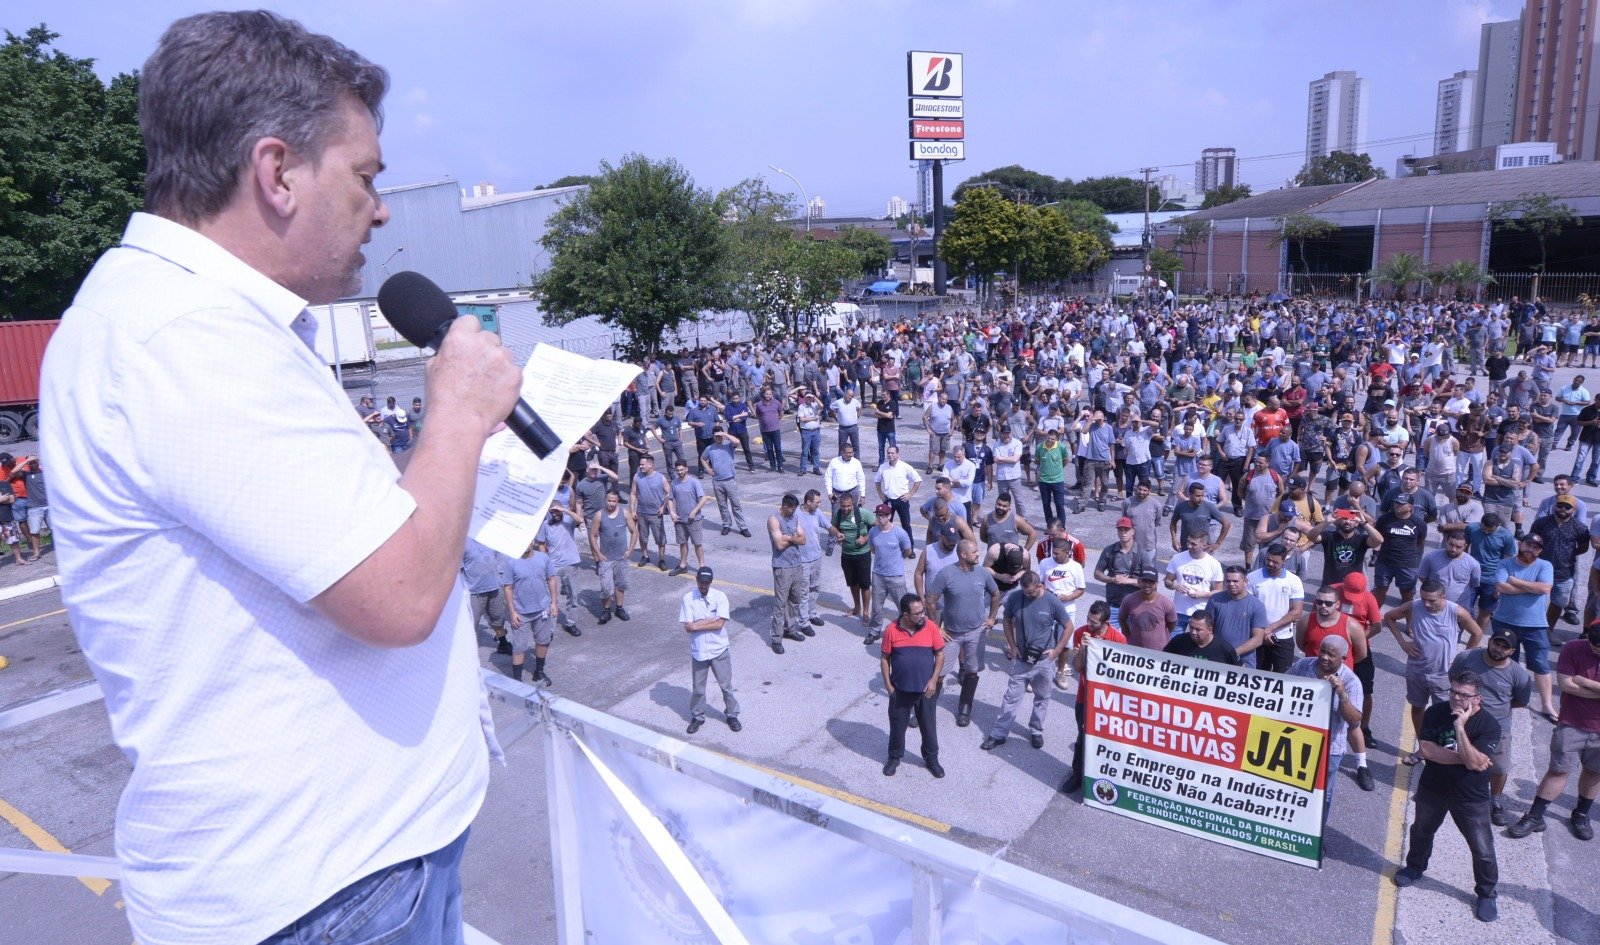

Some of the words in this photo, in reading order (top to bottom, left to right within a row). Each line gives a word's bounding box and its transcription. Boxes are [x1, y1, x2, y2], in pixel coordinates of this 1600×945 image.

[915, 104, 961, 112] BRIDGESTONE
[915, 125, 962, 133] Firestone
[920, 144, 957, 156] bandag
[1096, 663, 1208, 698] Concorrência
[1214, 686, 1284, 713] Desleal
[1289, 702, 1313, 717] !!!
[1102, 647, 1155, 669] Vamos
[1160, 659, 1188, 676] dar
[1194, 667, 1219, 682] um
[1226, 671, 1284, 694] BASTA
[1291, 686, 1314, 701] na
[1093, 688, 1237, 738] MEDIDAS
[1094, 712, 1236, 763] PROTETIVAS
[1096, 745, 1121, 762] Pro
[1126, 753, 1195, 781] Emprego
[1201, 772, 1224, 787] na
[1228, 778, 1308, 808] Indústria
[1246, 727, 1312, 781] JÁ!
[1100, 763, 1117, 777] de
[1122, 769, 1172, 792] PNEUS
[1177, 783, 1207, 802] Não
[1212, 790, 1295, 822] Acabar!!!
[1127, 791, 1182, 813] FEDERAÇÃO
[1185, 806, 1235, 827] NACIONAL
[1238, 820, 1252, 830] DA
[1256, 825, 1312, 846] BORRACHA
[1138, 803, 1143, 811] E
[1147, 806, 1203, 828] SINDICATOS
[1206, 821, 1252, 841] FILIADOS
[1254, 834, 1258, 842] /
[1261, 837, 1299, 852] BRASIL
